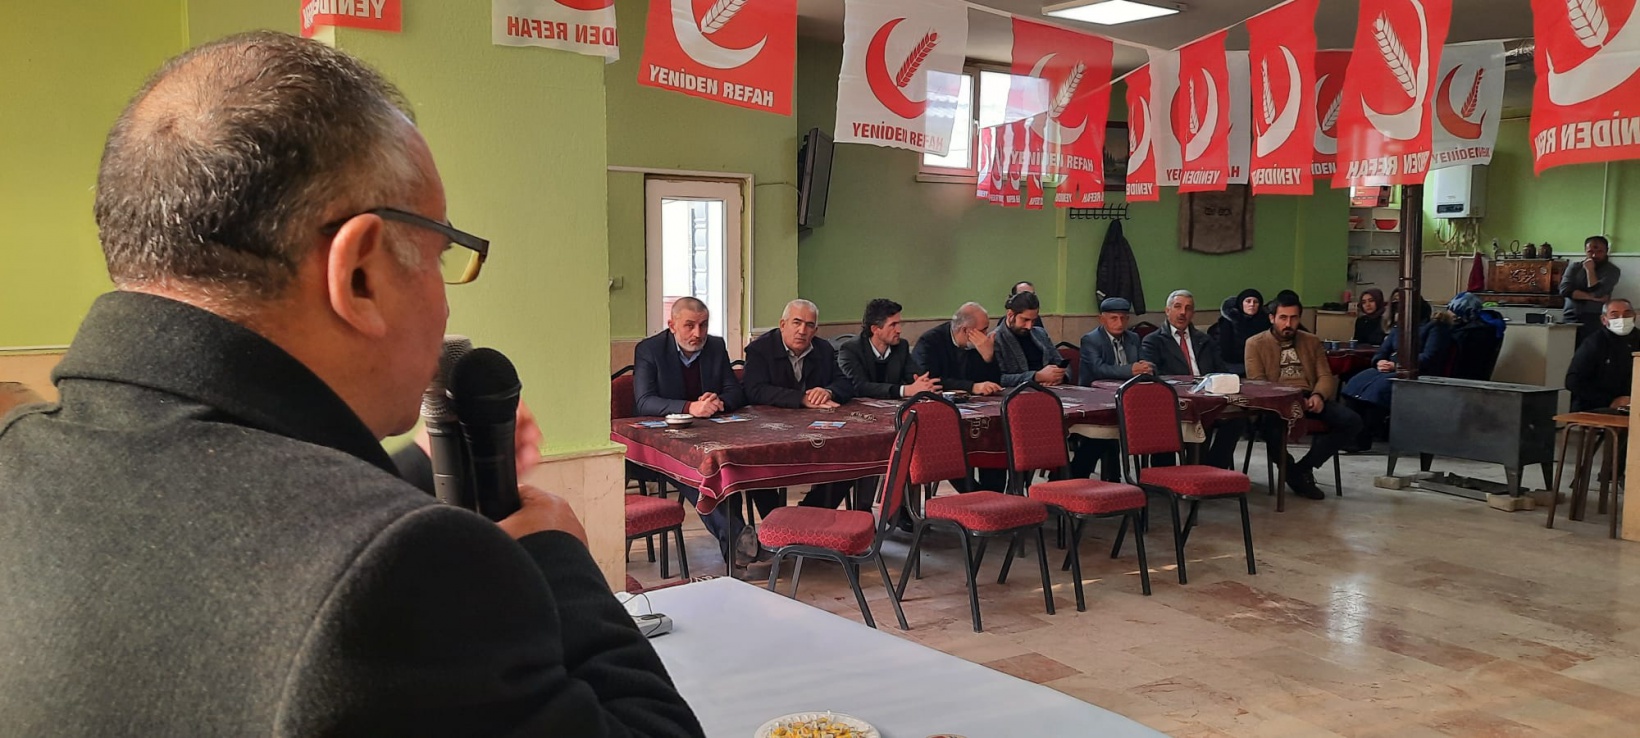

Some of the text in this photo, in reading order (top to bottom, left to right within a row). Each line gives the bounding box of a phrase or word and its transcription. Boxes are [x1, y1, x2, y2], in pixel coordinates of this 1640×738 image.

[649, 64, 774, 107] YENİDEN REFAH
[853, 121, 908, 143] YENİDEN
[1066, 154, 1094, 172] REFAH
